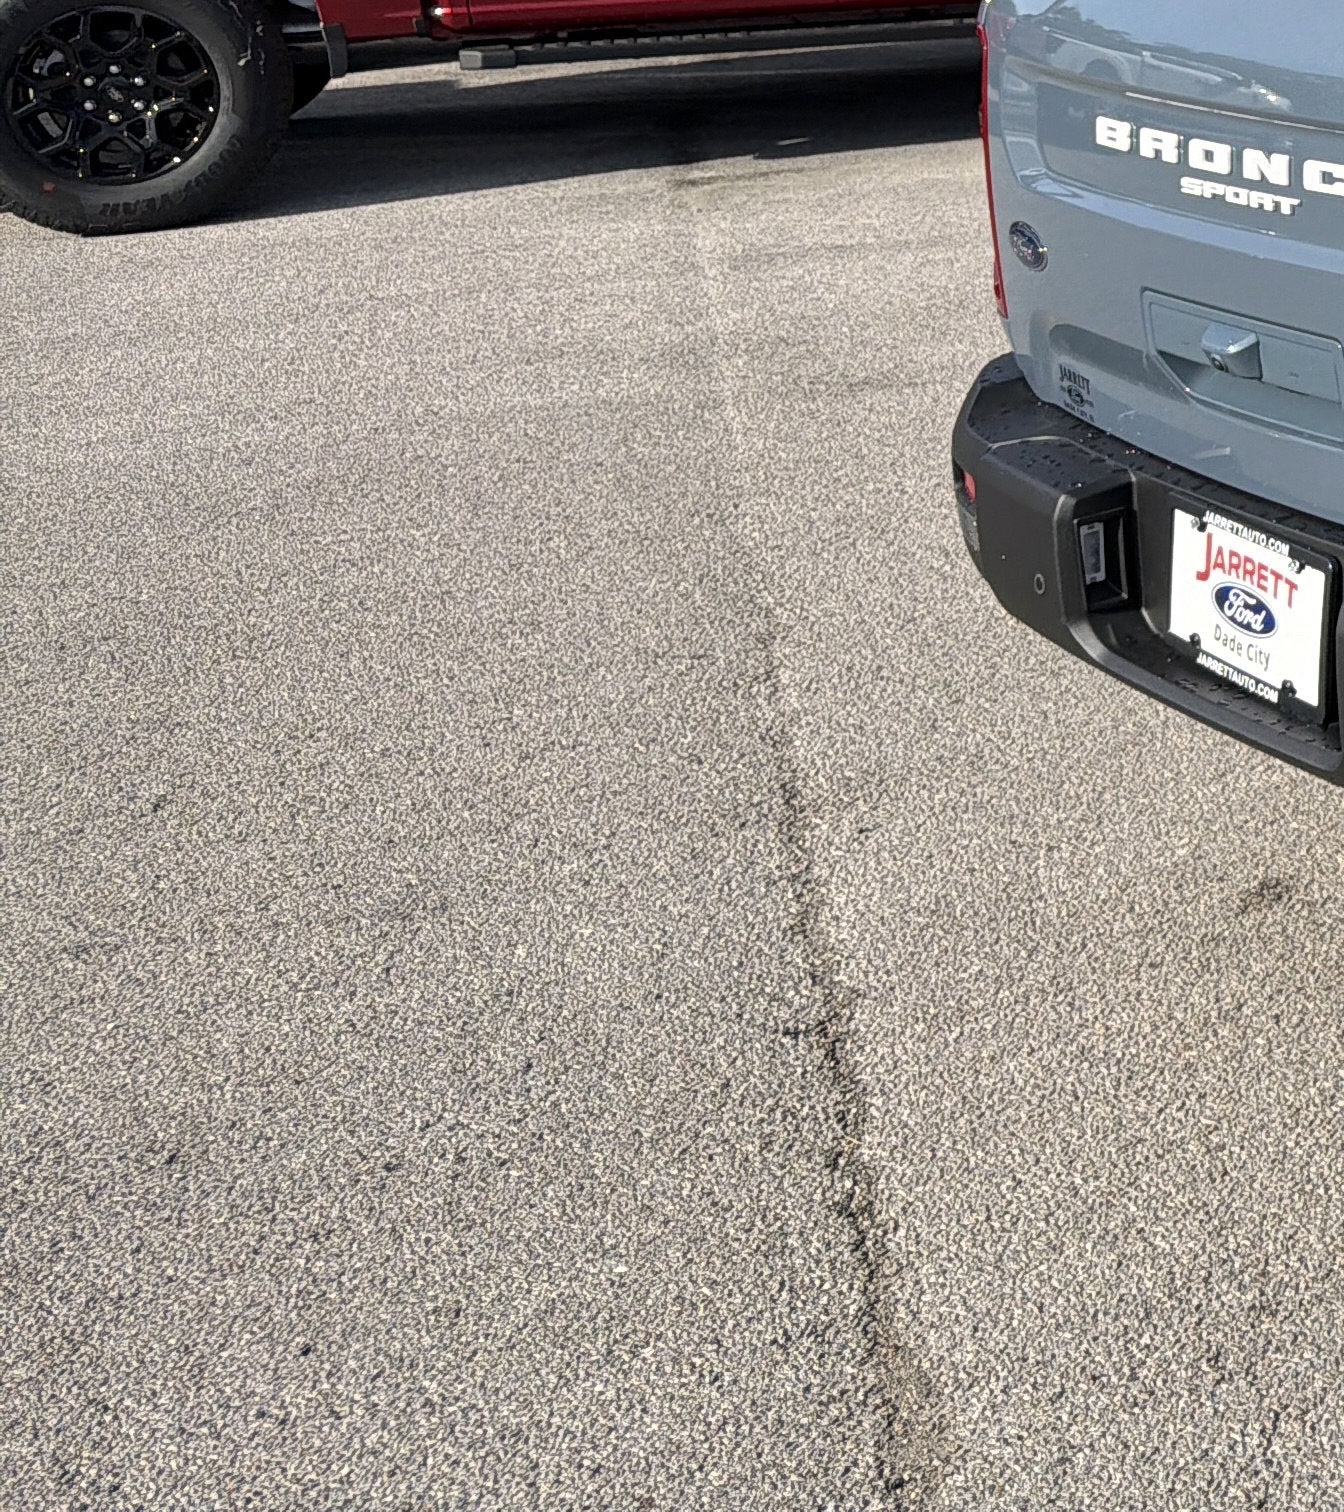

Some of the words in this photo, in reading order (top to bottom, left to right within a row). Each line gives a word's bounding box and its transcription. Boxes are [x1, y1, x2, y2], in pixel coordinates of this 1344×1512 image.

[1180, 176, 1301, 215] SPORT
[1202, 510, 1290, 556] JARRETTAUTO.COM
[1196, 532, 1299, 609] JARRETT
[1223, 588, 1266, 631] Ford
[1214, 623, 1243, 657] Dade
[1246, 643, 1271, 672] City
[1196, 652, 1279, 703] JARRETTAUTO.COM
